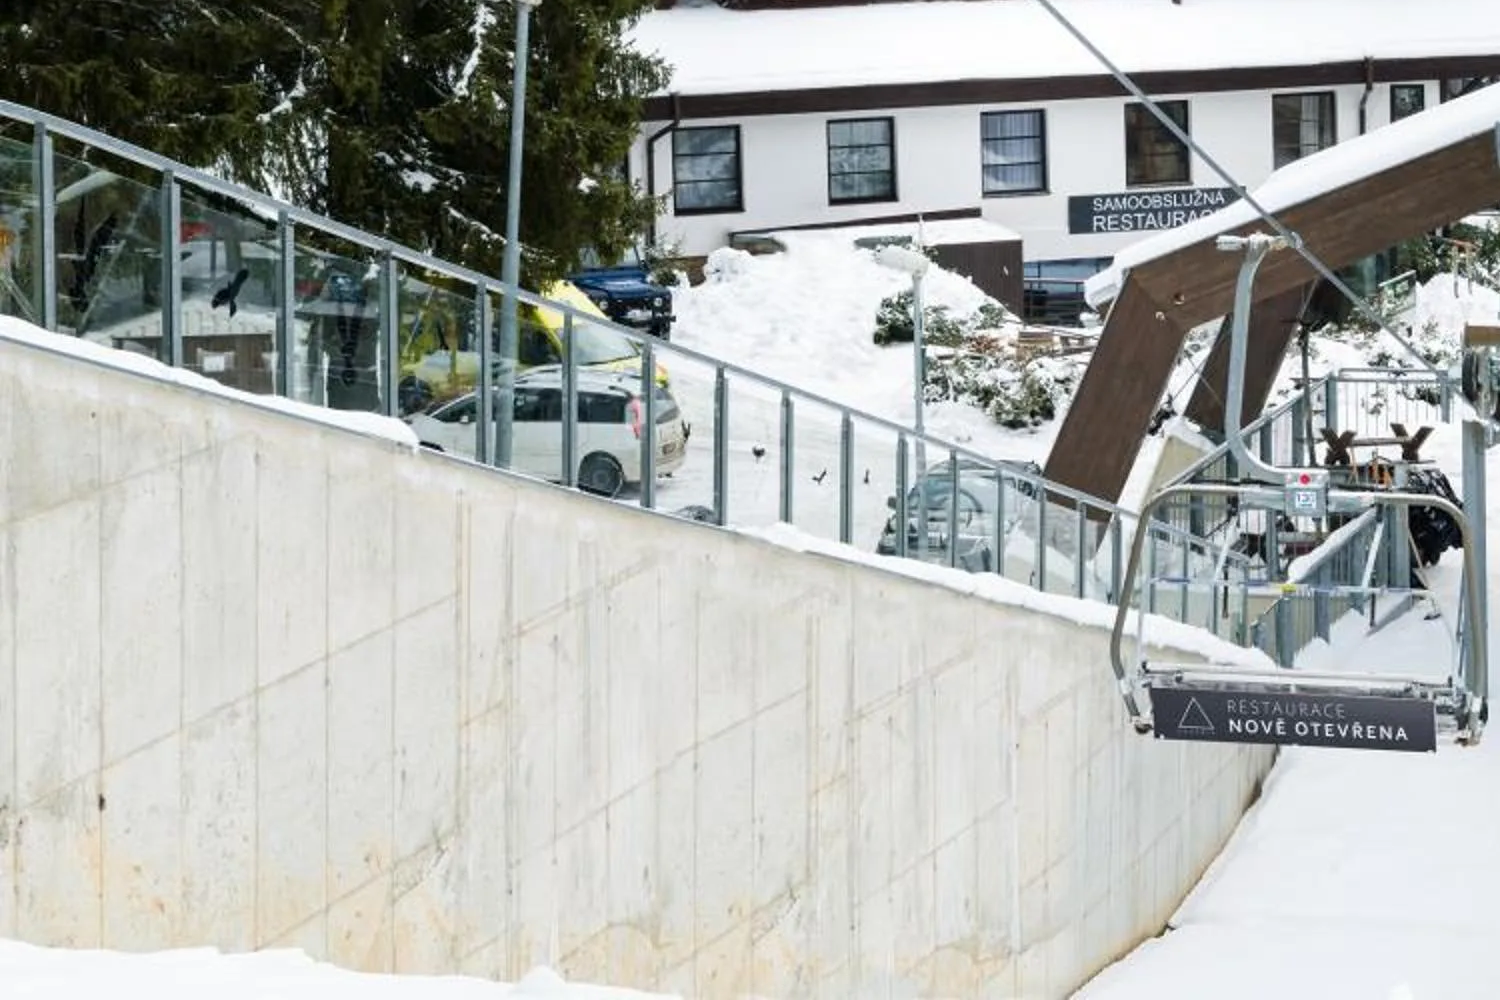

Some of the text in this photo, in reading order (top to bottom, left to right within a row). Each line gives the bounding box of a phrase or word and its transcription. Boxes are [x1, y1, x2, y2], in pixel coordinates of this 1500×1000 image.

[1093, 190, 1225, 212] SAMOOBSLUŽNA
[1227, 699, 1346, 719] RESTAURACE
[1295, 721, 1408, 741] OTEVŘENA
